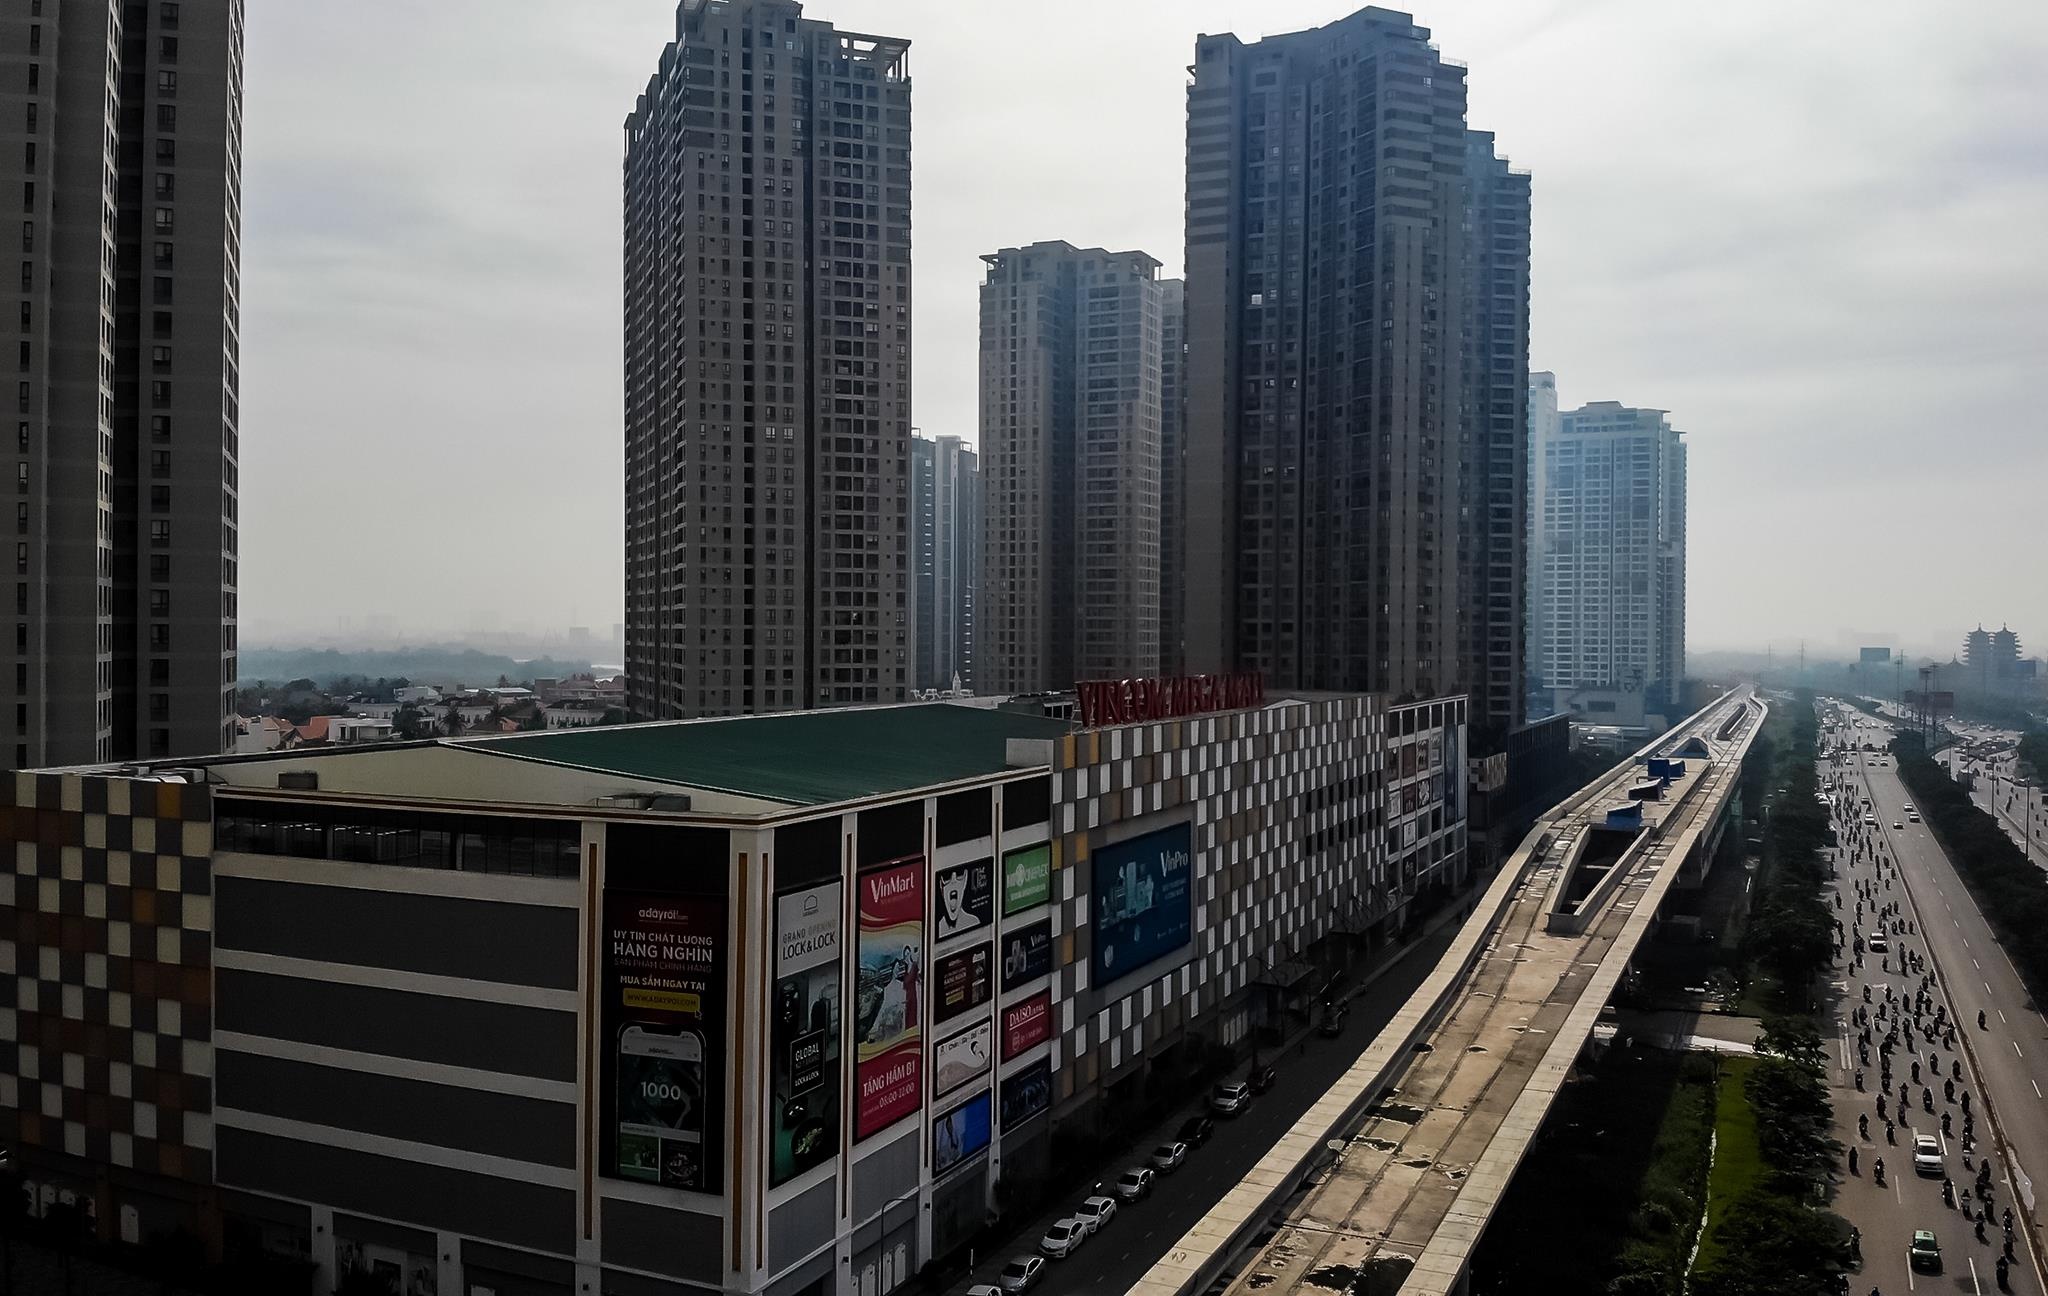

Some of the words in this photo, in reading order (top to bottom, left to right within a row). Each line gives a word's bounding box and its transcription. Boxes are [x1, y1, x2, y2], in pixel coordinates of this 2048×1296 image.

[1160, 850, 1189, 878] VinPro
[870, 871, 915, 903] VinMart
[783, 928, 806, 944] GRAND
[620, 975, 640, 985] MUA
[663, 979, 688, 990] NGAY
[1010, 1005, 1031, 1027] DAISO
[795, 1042, 820, 1062] GLOBAL
[640, 1081, 681, 1101] 1000
